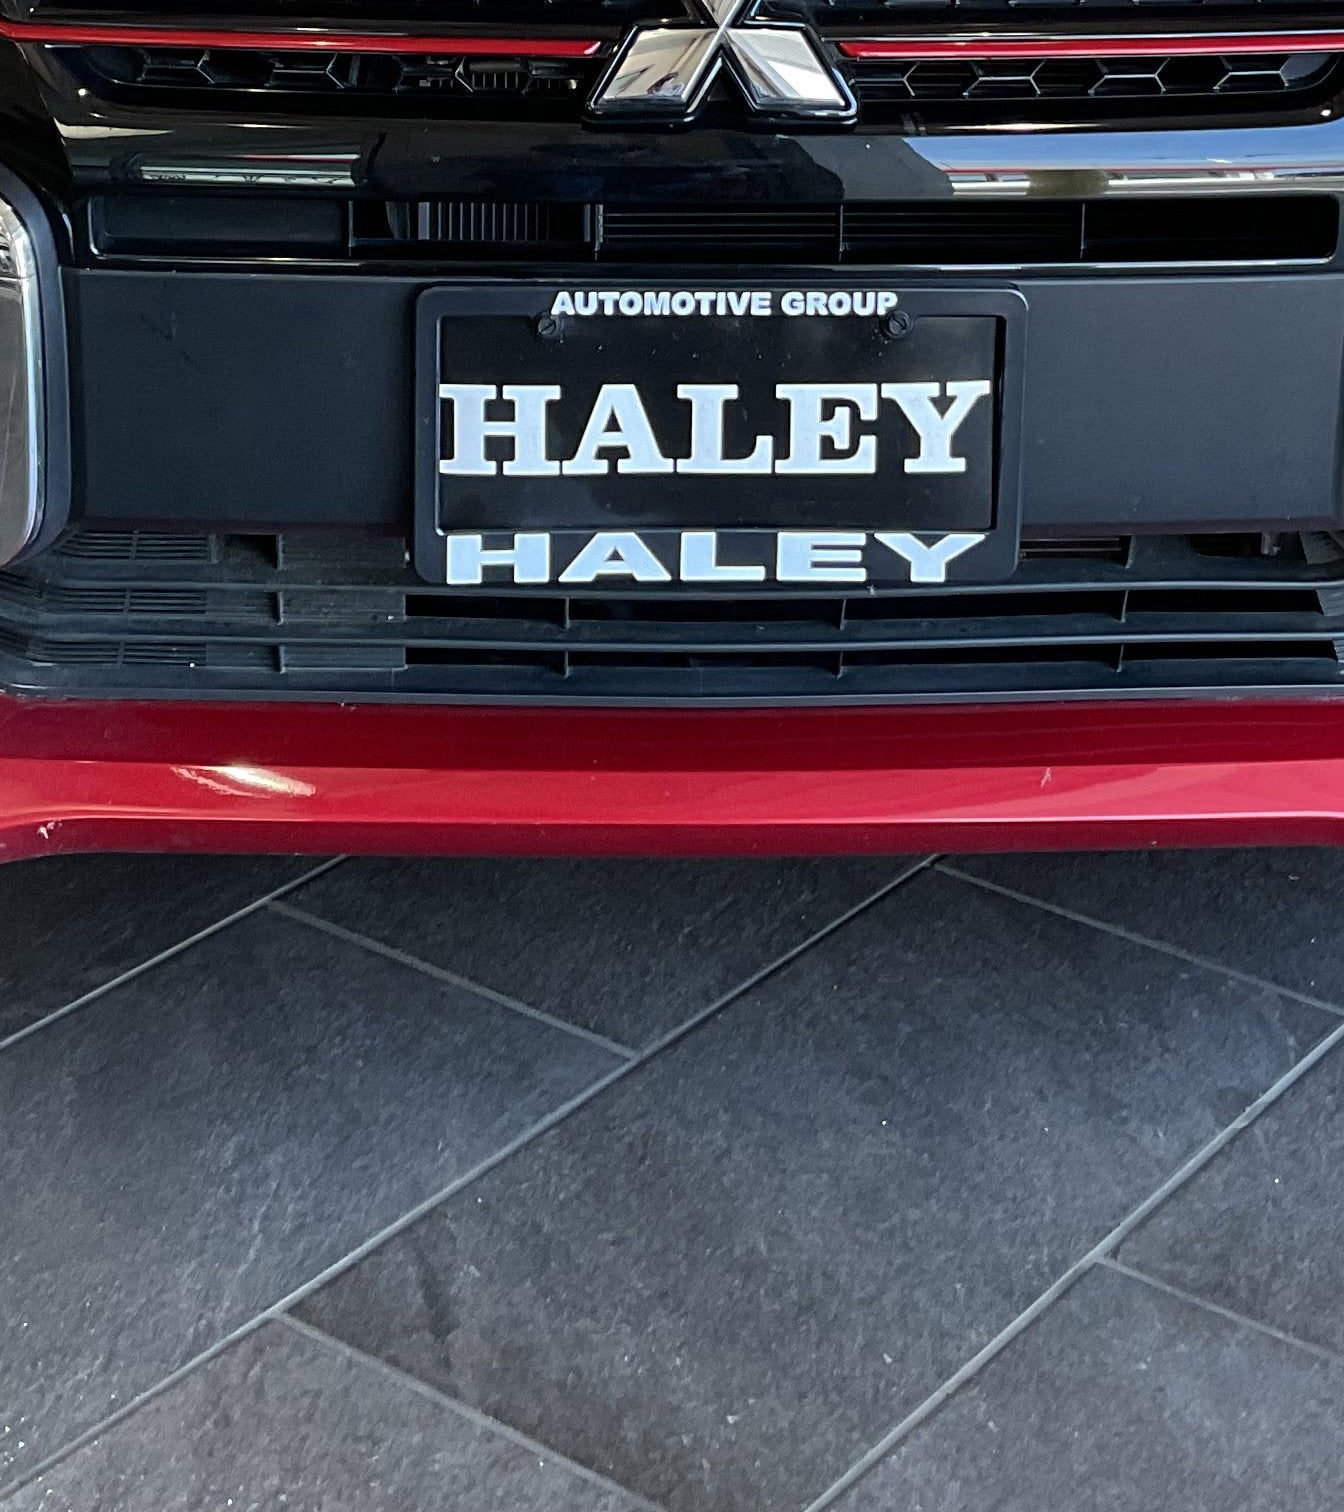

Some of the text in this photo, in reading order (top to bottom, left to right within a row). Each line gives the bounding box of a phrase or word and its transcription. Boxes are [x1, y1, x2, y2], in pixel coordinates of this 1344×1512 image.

[550, 290, 898, 316] AUTOMOTIVE GROUP
[439, 380, 991, 475] HALEY
[445, 531, 987, 585] HALEY
